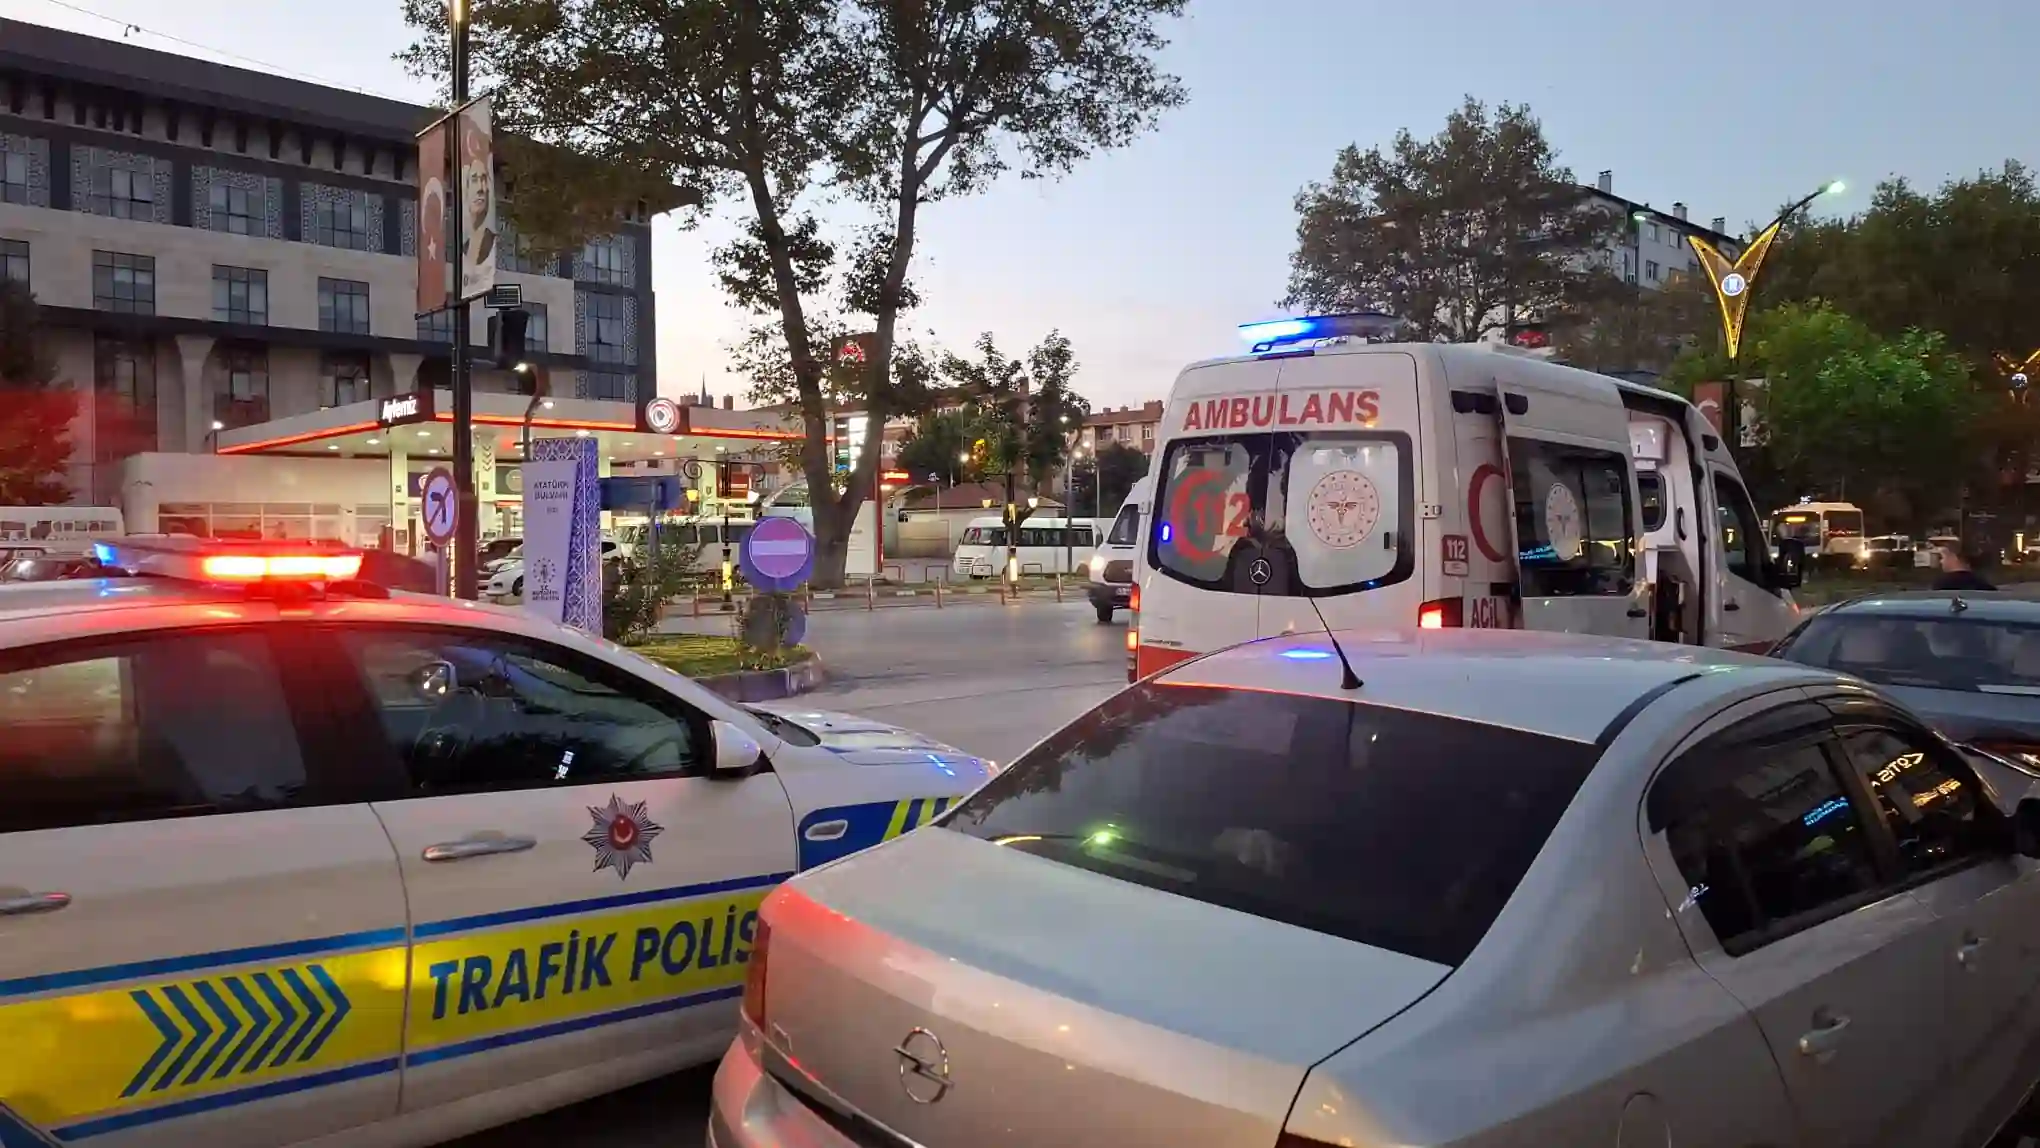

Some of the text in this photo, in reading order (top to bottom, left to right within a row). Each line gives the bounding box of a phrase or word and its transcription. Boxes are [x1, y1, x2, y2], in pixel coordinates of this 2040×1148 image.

[1183, 391, 1380, 430] AMBULANS
[1193, 492, 1251, 537] 112
[1447, 539, 1466, 559] 112
[429, 929, 618, 1020] TRAFİK
